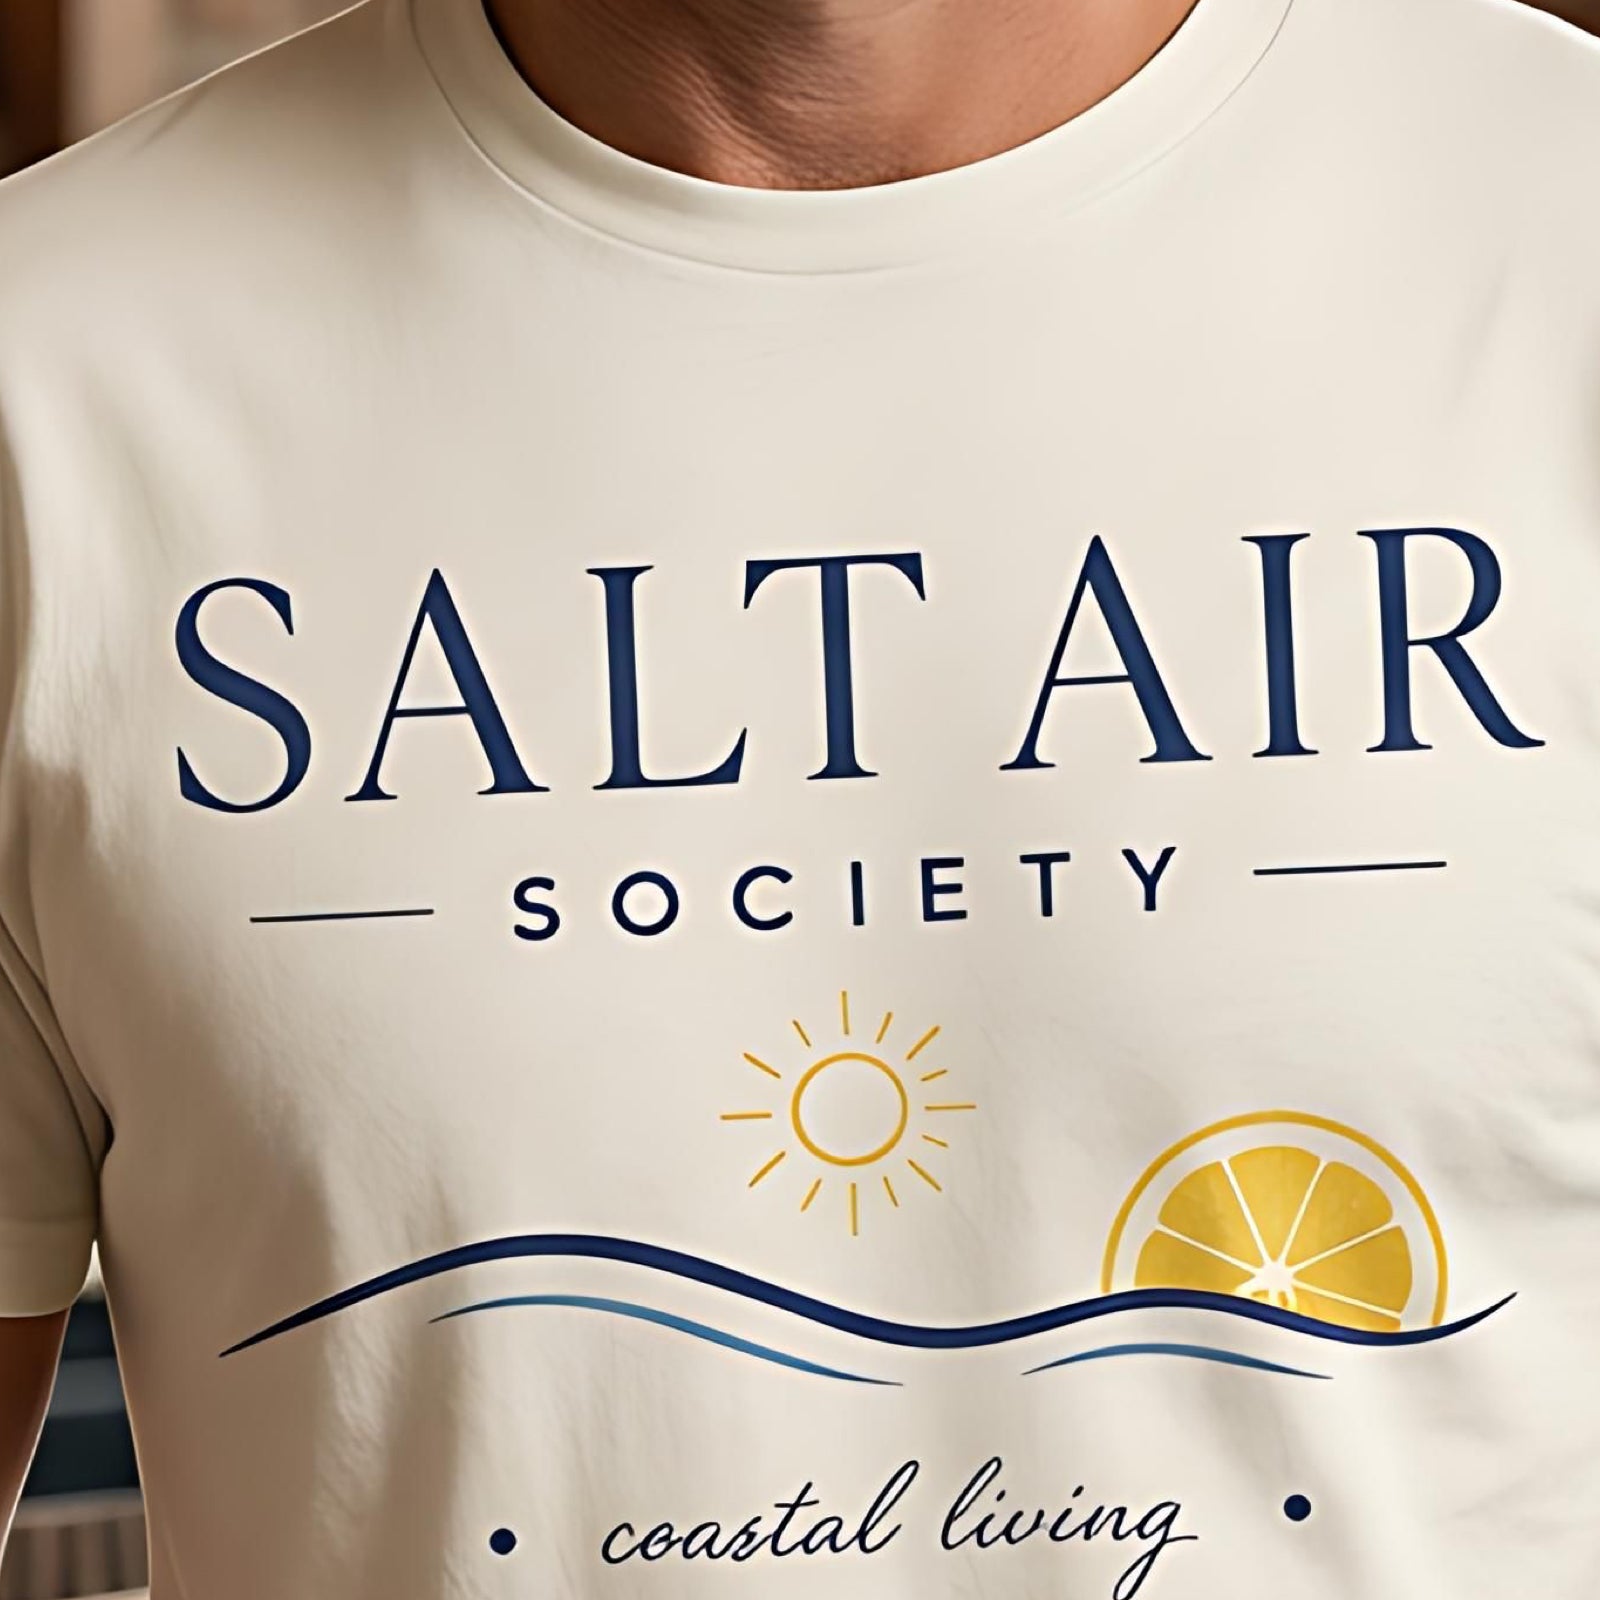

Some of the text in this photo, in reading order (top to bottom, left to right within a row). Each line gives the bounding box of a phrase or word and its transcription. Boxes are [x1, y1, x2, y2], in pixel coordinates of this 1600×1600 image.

[173, 525, 1548, 816] SALT AIR
[511, 844, 1179, 944] SOCIETY
[599, 1457, 922, 1567] coastal
